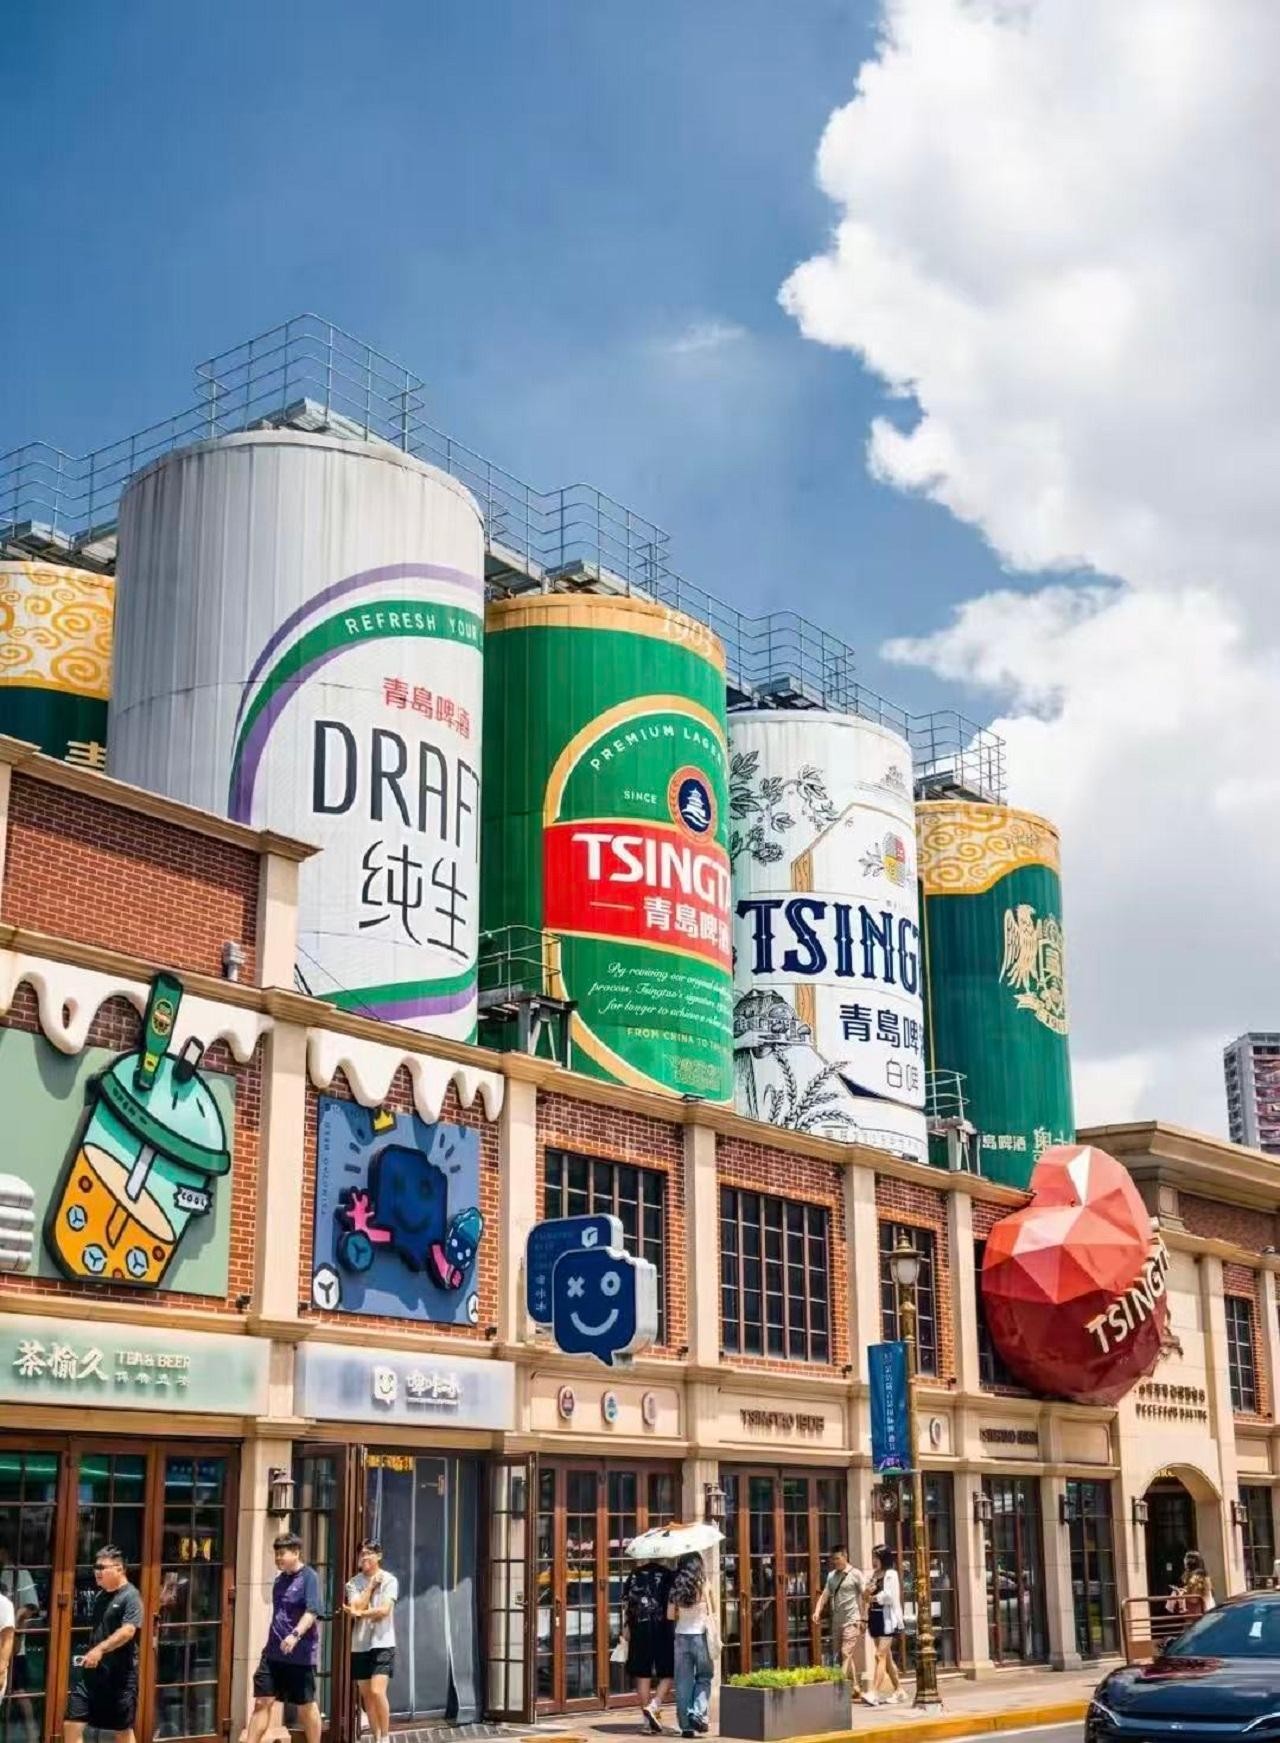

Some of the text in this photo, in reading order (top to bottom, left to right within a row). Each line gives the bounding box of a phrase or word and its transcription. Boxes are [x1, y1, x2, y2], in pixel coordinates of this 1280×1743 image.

[344, 612, 436, 635] REFRESH
[448, 617, 477, 640] YOUR
[382, 677, 471, 740] 青島啤酒
[590, 724, 675, 772] PREMIUM
[624, 790, 657, 804] SINCE
[358, 839, 469, 959] 纯生
[627, 1026, 660, 1040] FROM
[663, 1030, 694, 1044] CHINA
[839, 1003, 923, 1058] 青島啤
[157, 1353, 191, 1369] BEER
